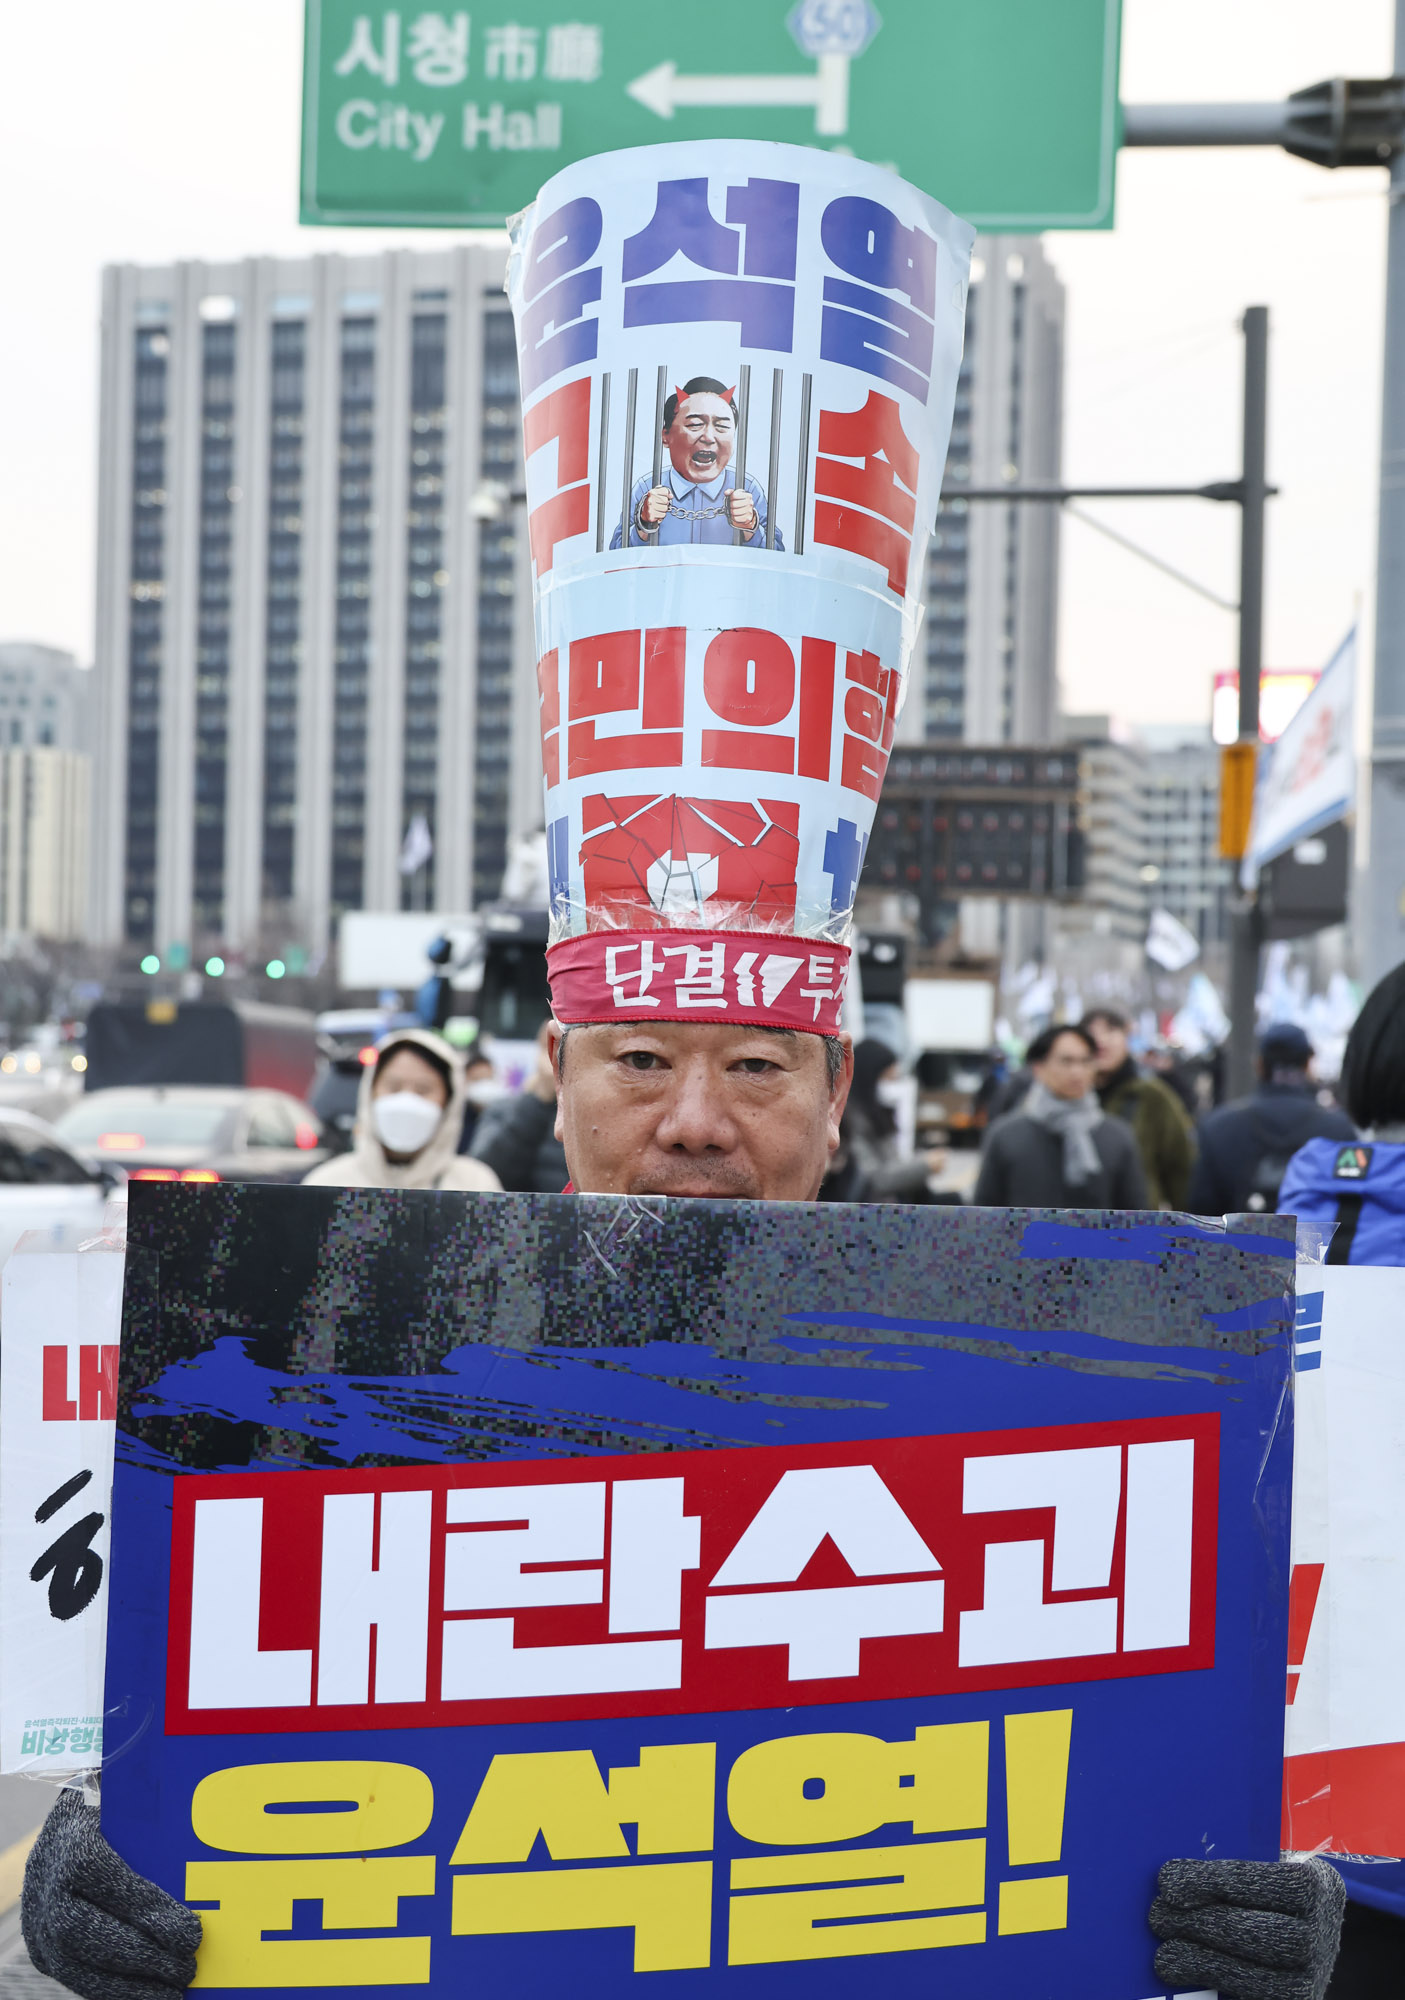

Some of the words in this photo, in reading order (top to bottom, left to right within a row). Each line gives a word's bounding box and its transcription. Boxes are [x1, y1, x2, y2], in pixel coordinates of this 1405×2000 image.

[335, 11, 470, 86] 시청
[335, 99, 444, 161] City
[462, 102, 561, 150] Hall
[522, 177, 937, 406] 윤석열
[605, 940, 728, 1008] 단결
[188, 1438, 1195, 1710] 내란수괴
[184, 1708, 1073, 1988] 윤석열!
